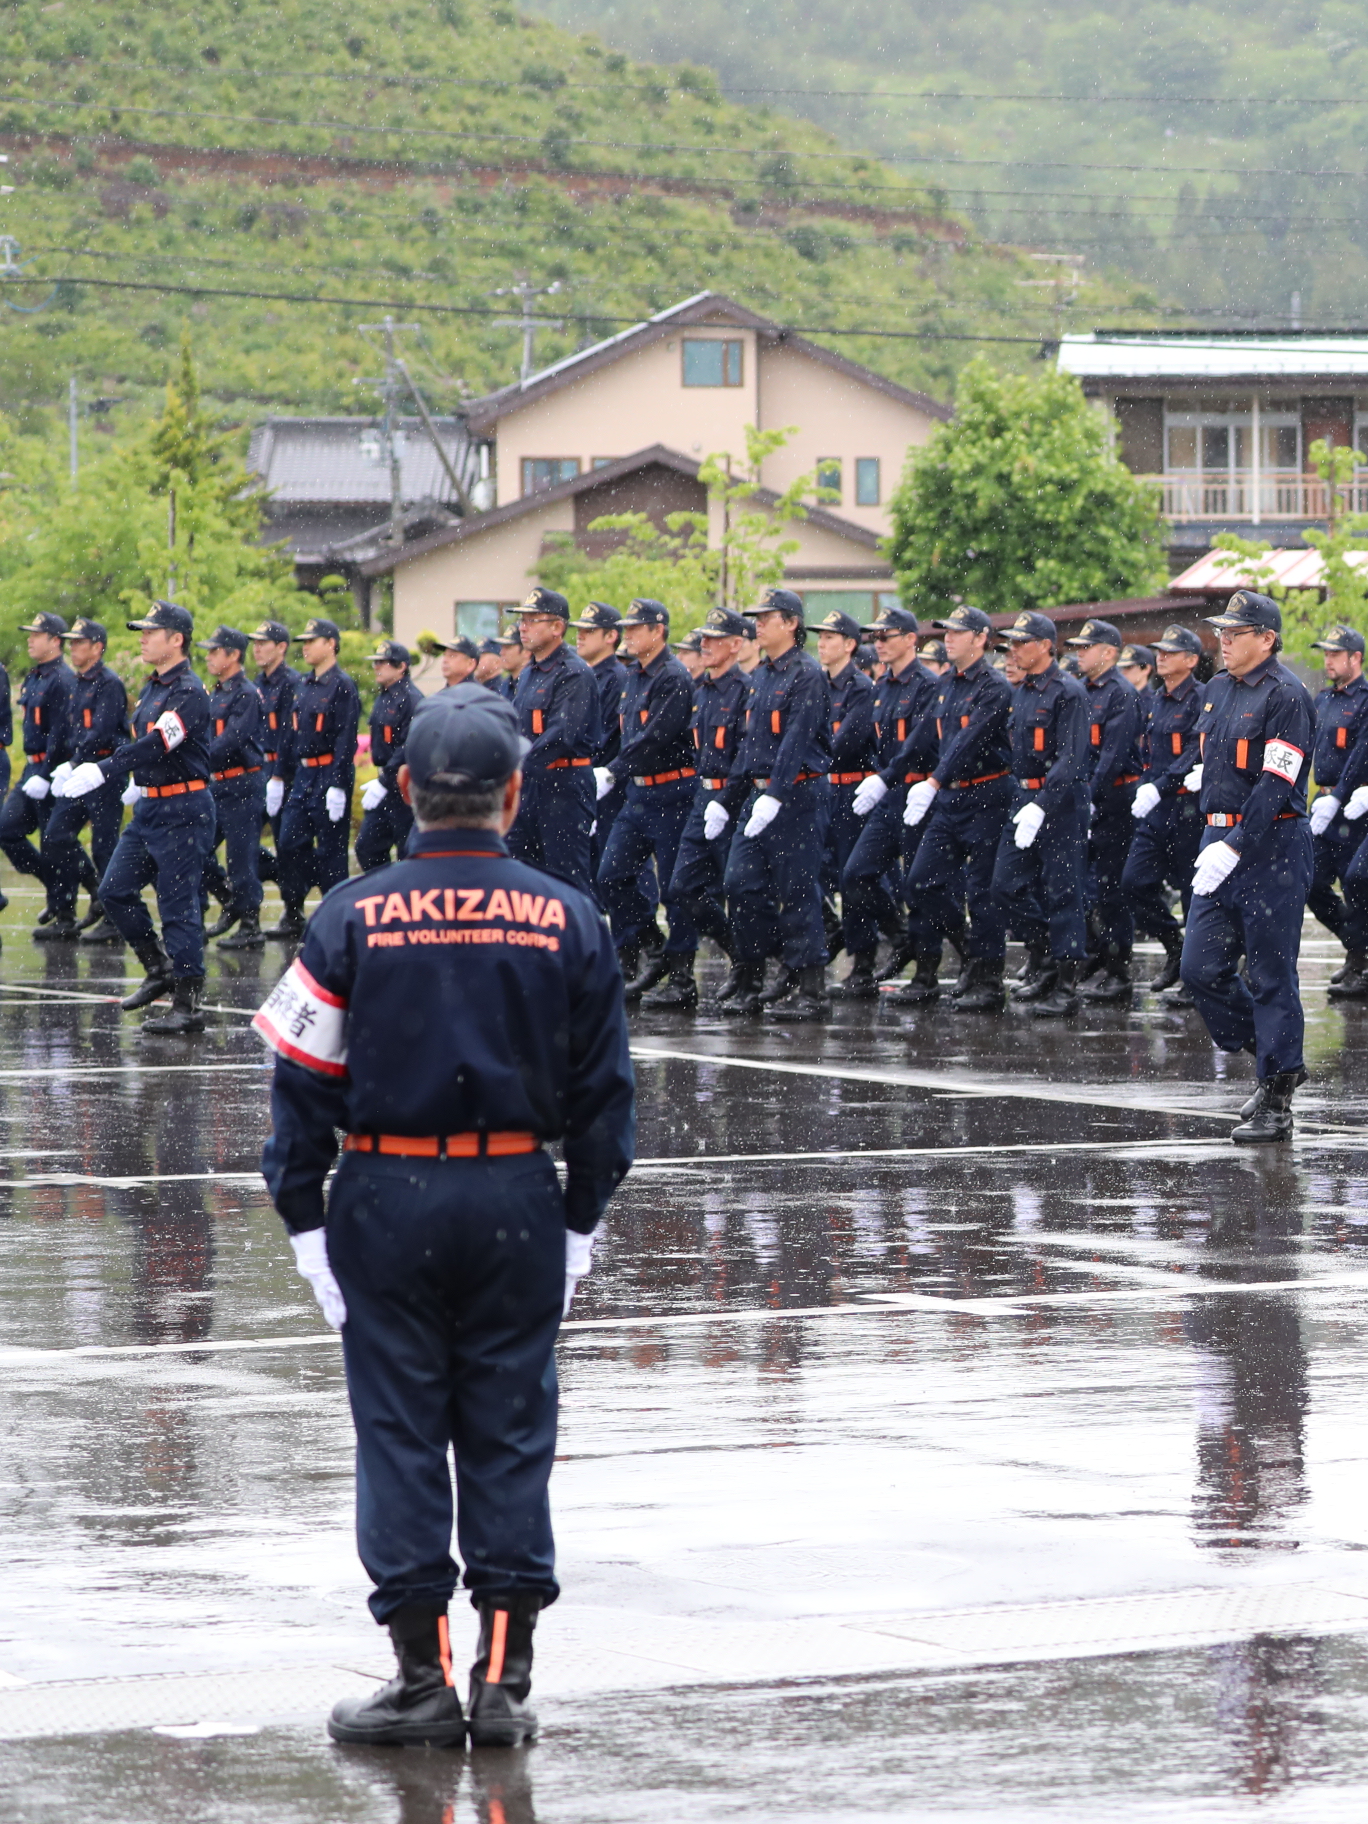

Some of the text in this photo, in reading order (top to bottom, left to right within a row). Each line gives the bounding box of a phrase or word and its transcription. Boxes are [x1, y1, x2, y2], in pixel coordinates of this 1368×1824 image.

[354, 888, 566, 931] TAKIZAWA
[367, 928, 560, 952] FIRE VOLUNTEER CORPS
